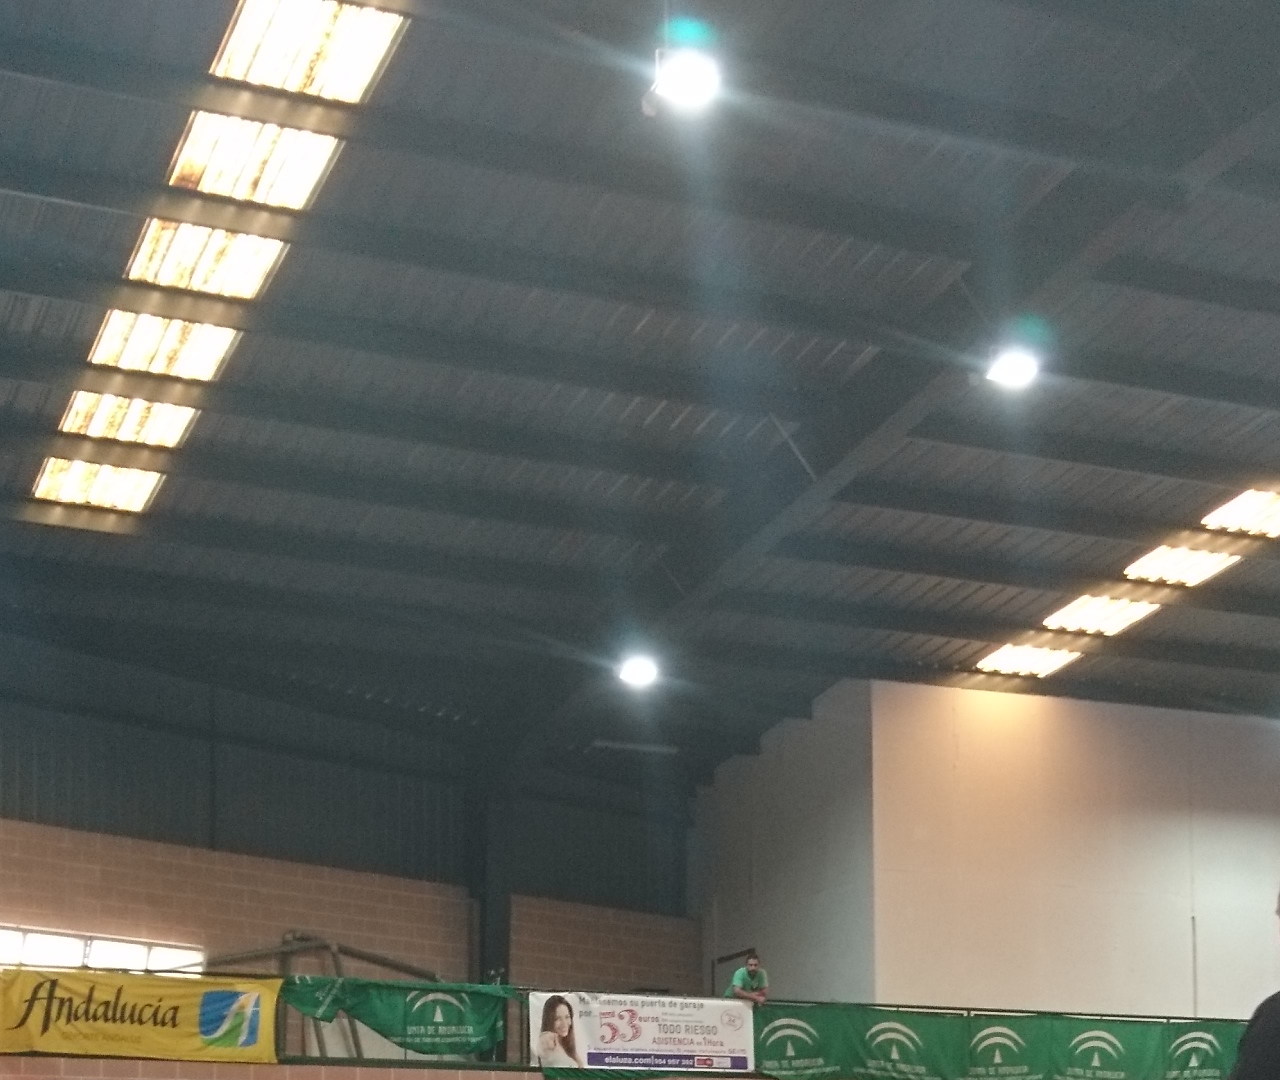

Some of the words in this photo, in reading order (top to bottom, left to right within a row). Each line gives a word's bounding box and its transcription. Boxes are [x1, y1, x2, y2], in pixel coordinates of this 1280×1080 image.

[599, 1009, 642, 1044] 53
[657, 1023, 681, 1034] TODO
[684, 1025, 718, 1036] RIESGO
